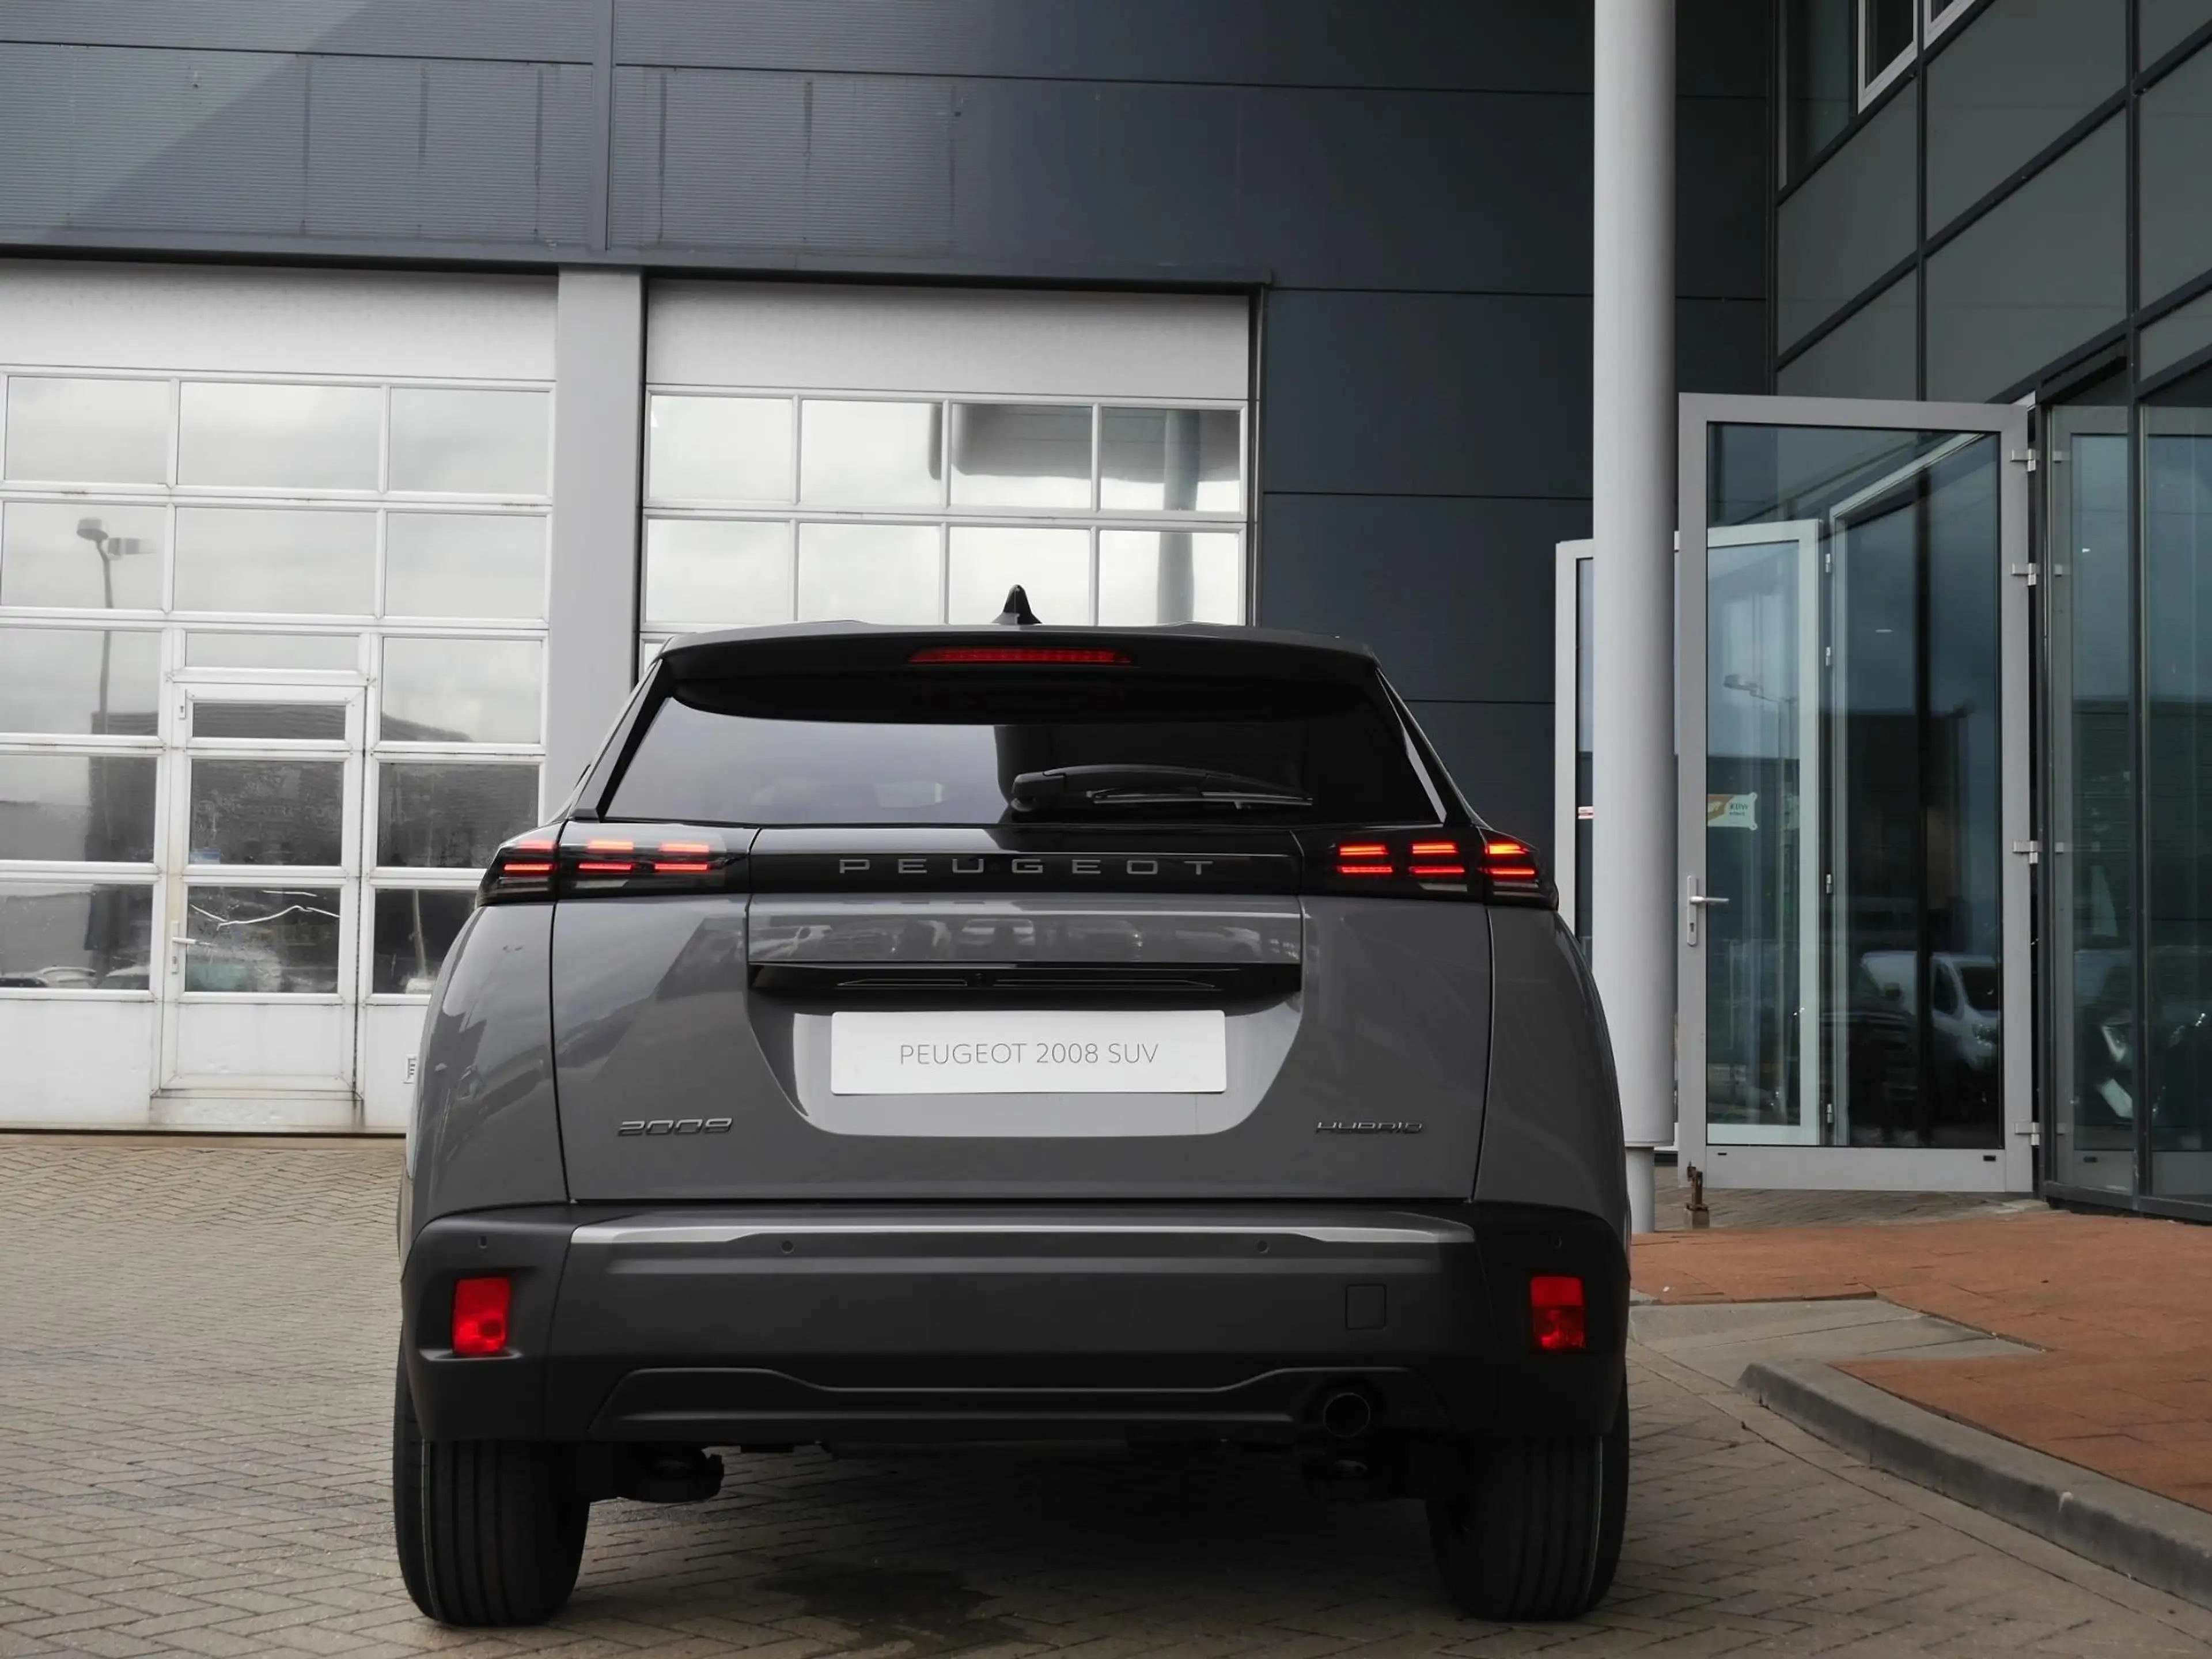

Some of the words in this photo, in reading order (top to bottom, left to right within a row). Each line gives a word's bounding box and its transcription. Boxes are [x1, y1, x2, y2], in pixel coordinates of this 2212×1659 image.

[839, 858, 1213, 875] PEUGEOT
[900, 1043, 1028, 1065] PEUGEOT
[1036, 1043, 1099, 1063] 2008
[1108, 1043, 1159, 1063] SUV
[618, 1118, 733, 1137] 2008
[1316, 1122, 1423, 1135] HYBRID
